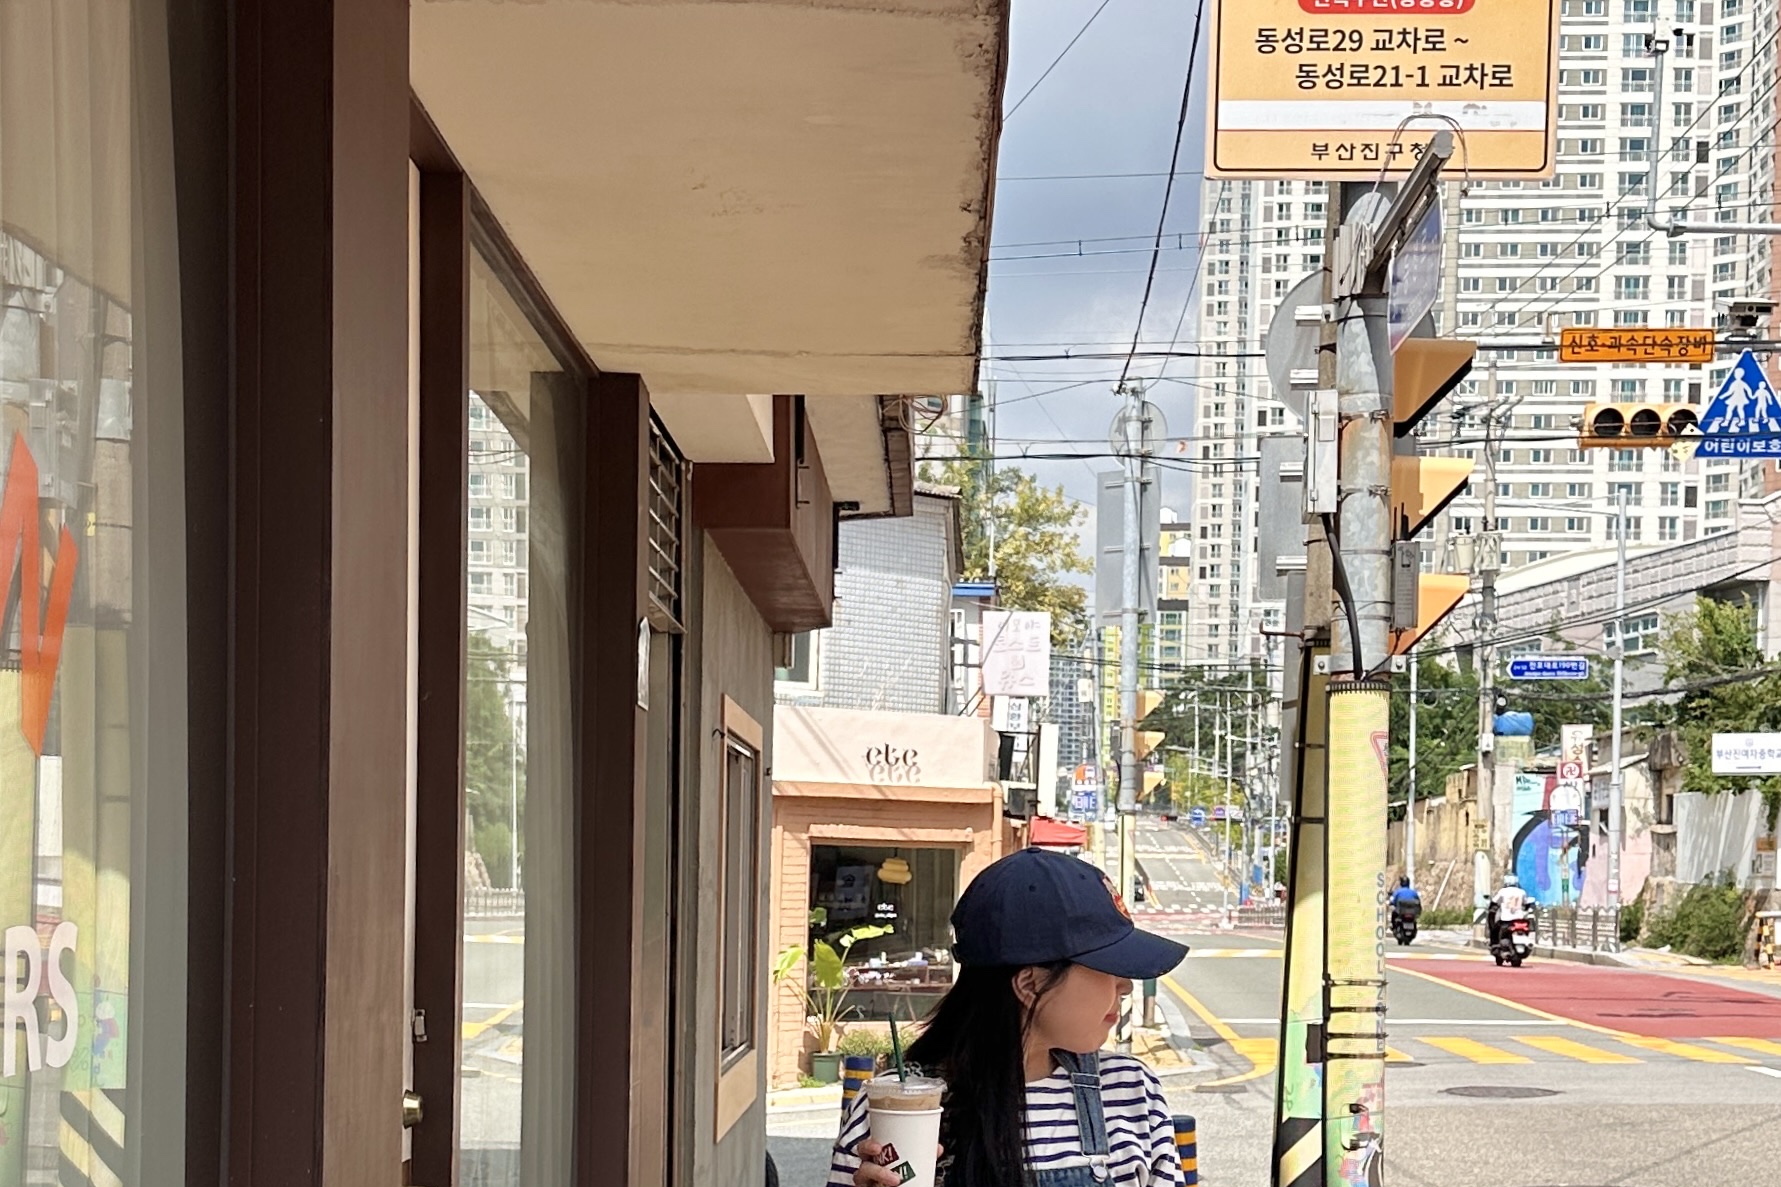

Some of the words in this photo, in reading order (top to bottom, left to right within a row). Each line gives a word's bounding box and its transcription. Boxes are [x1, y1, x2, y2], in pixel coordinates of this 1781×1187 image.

[1254, 27, 1364, 54] 동성로29
[1370, 27, 1447, 54] 교차로
[1295, 63, 1430, 90] 동성로21-1
[1437, 63, 1514, 90] 교차로
